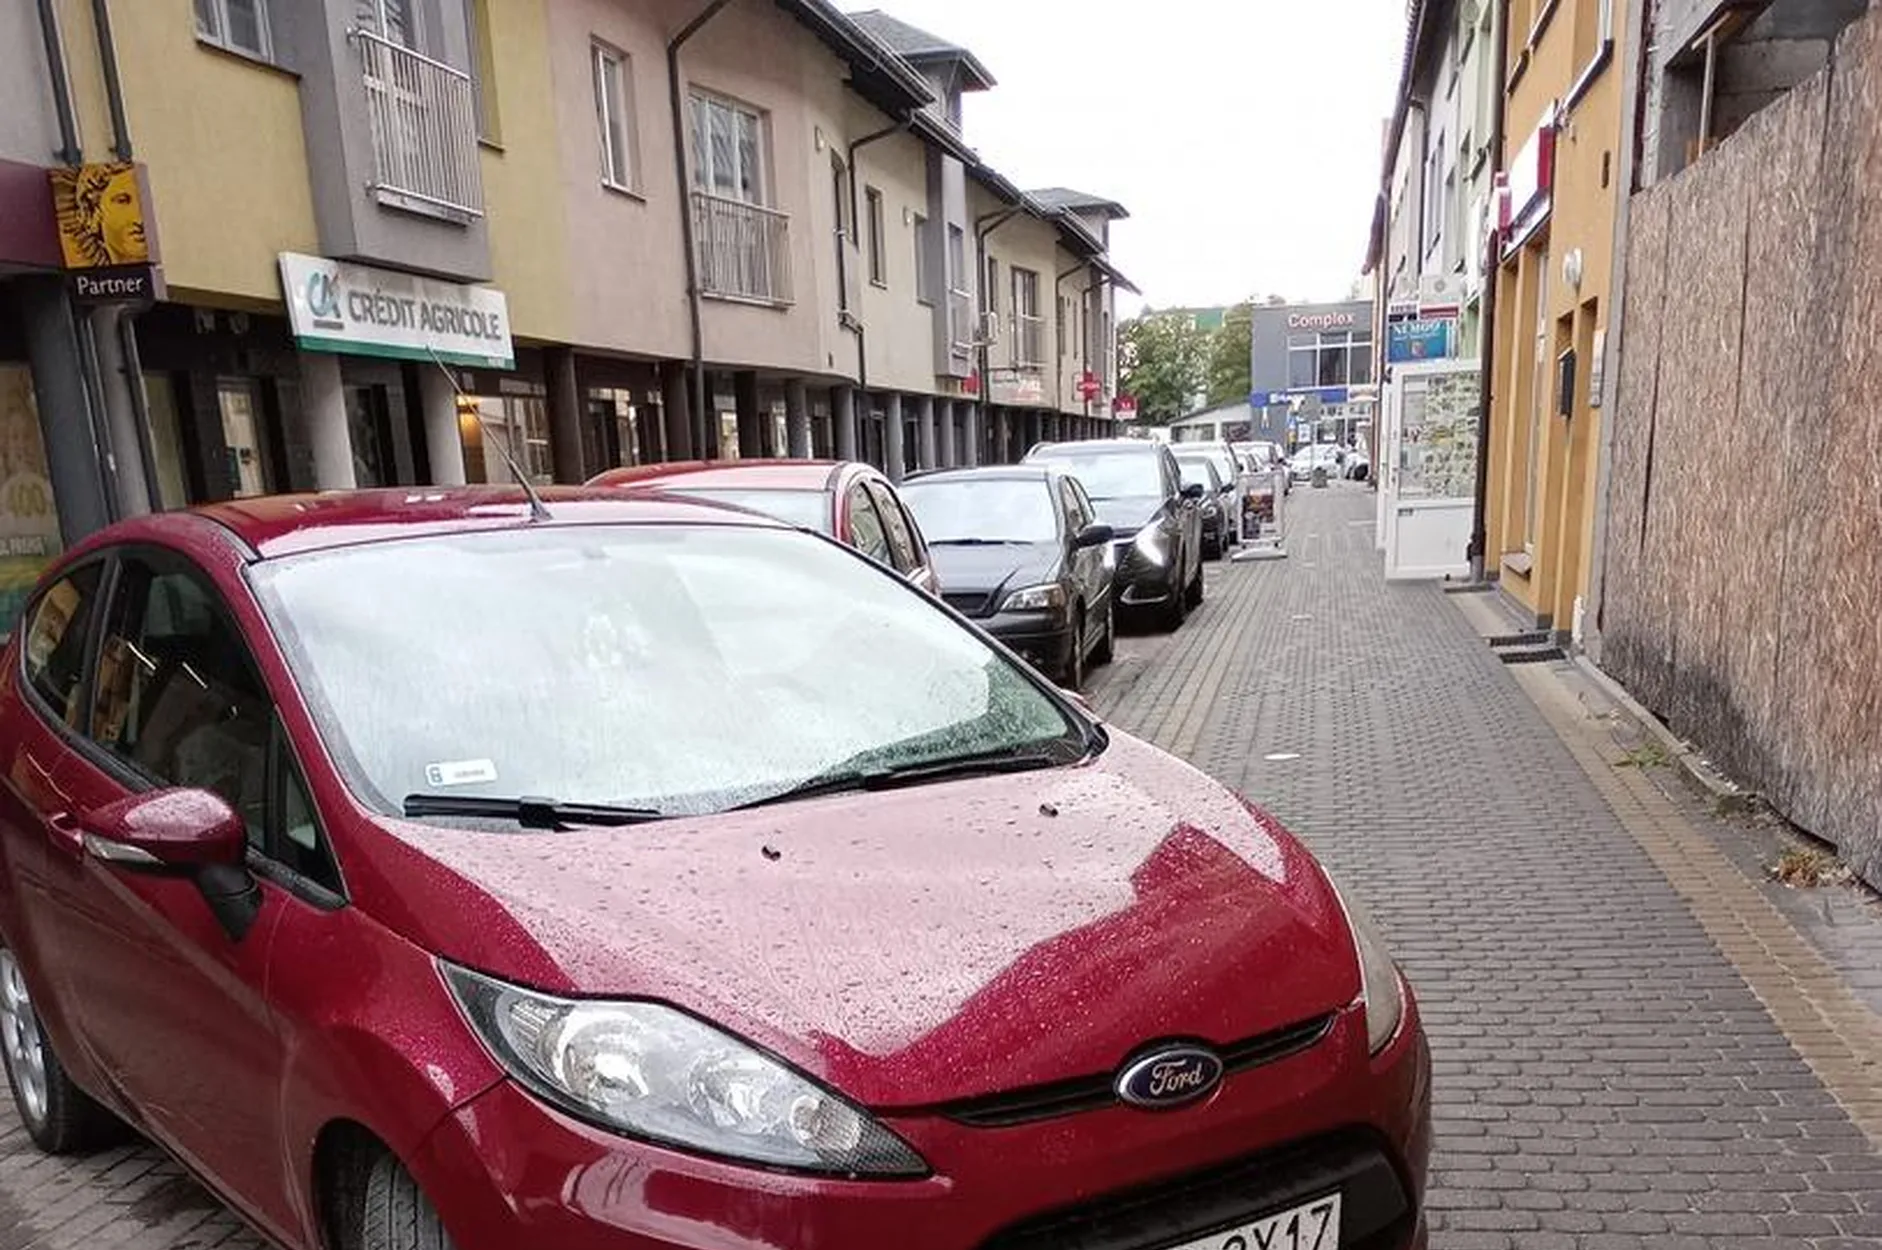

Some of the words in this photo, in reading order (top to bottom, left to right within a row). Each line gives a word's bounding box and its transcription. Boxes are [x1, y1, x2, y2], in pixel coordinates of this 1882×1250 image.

[77, 276, 144, 295] Partner
[348, 288, 415, 331] CRÉDIT
[420, 303, 502, 341] AGRICOLE
[1288, 312, 1356, 329] Complex
[1149, 1059, 1204, 1096] Ford
